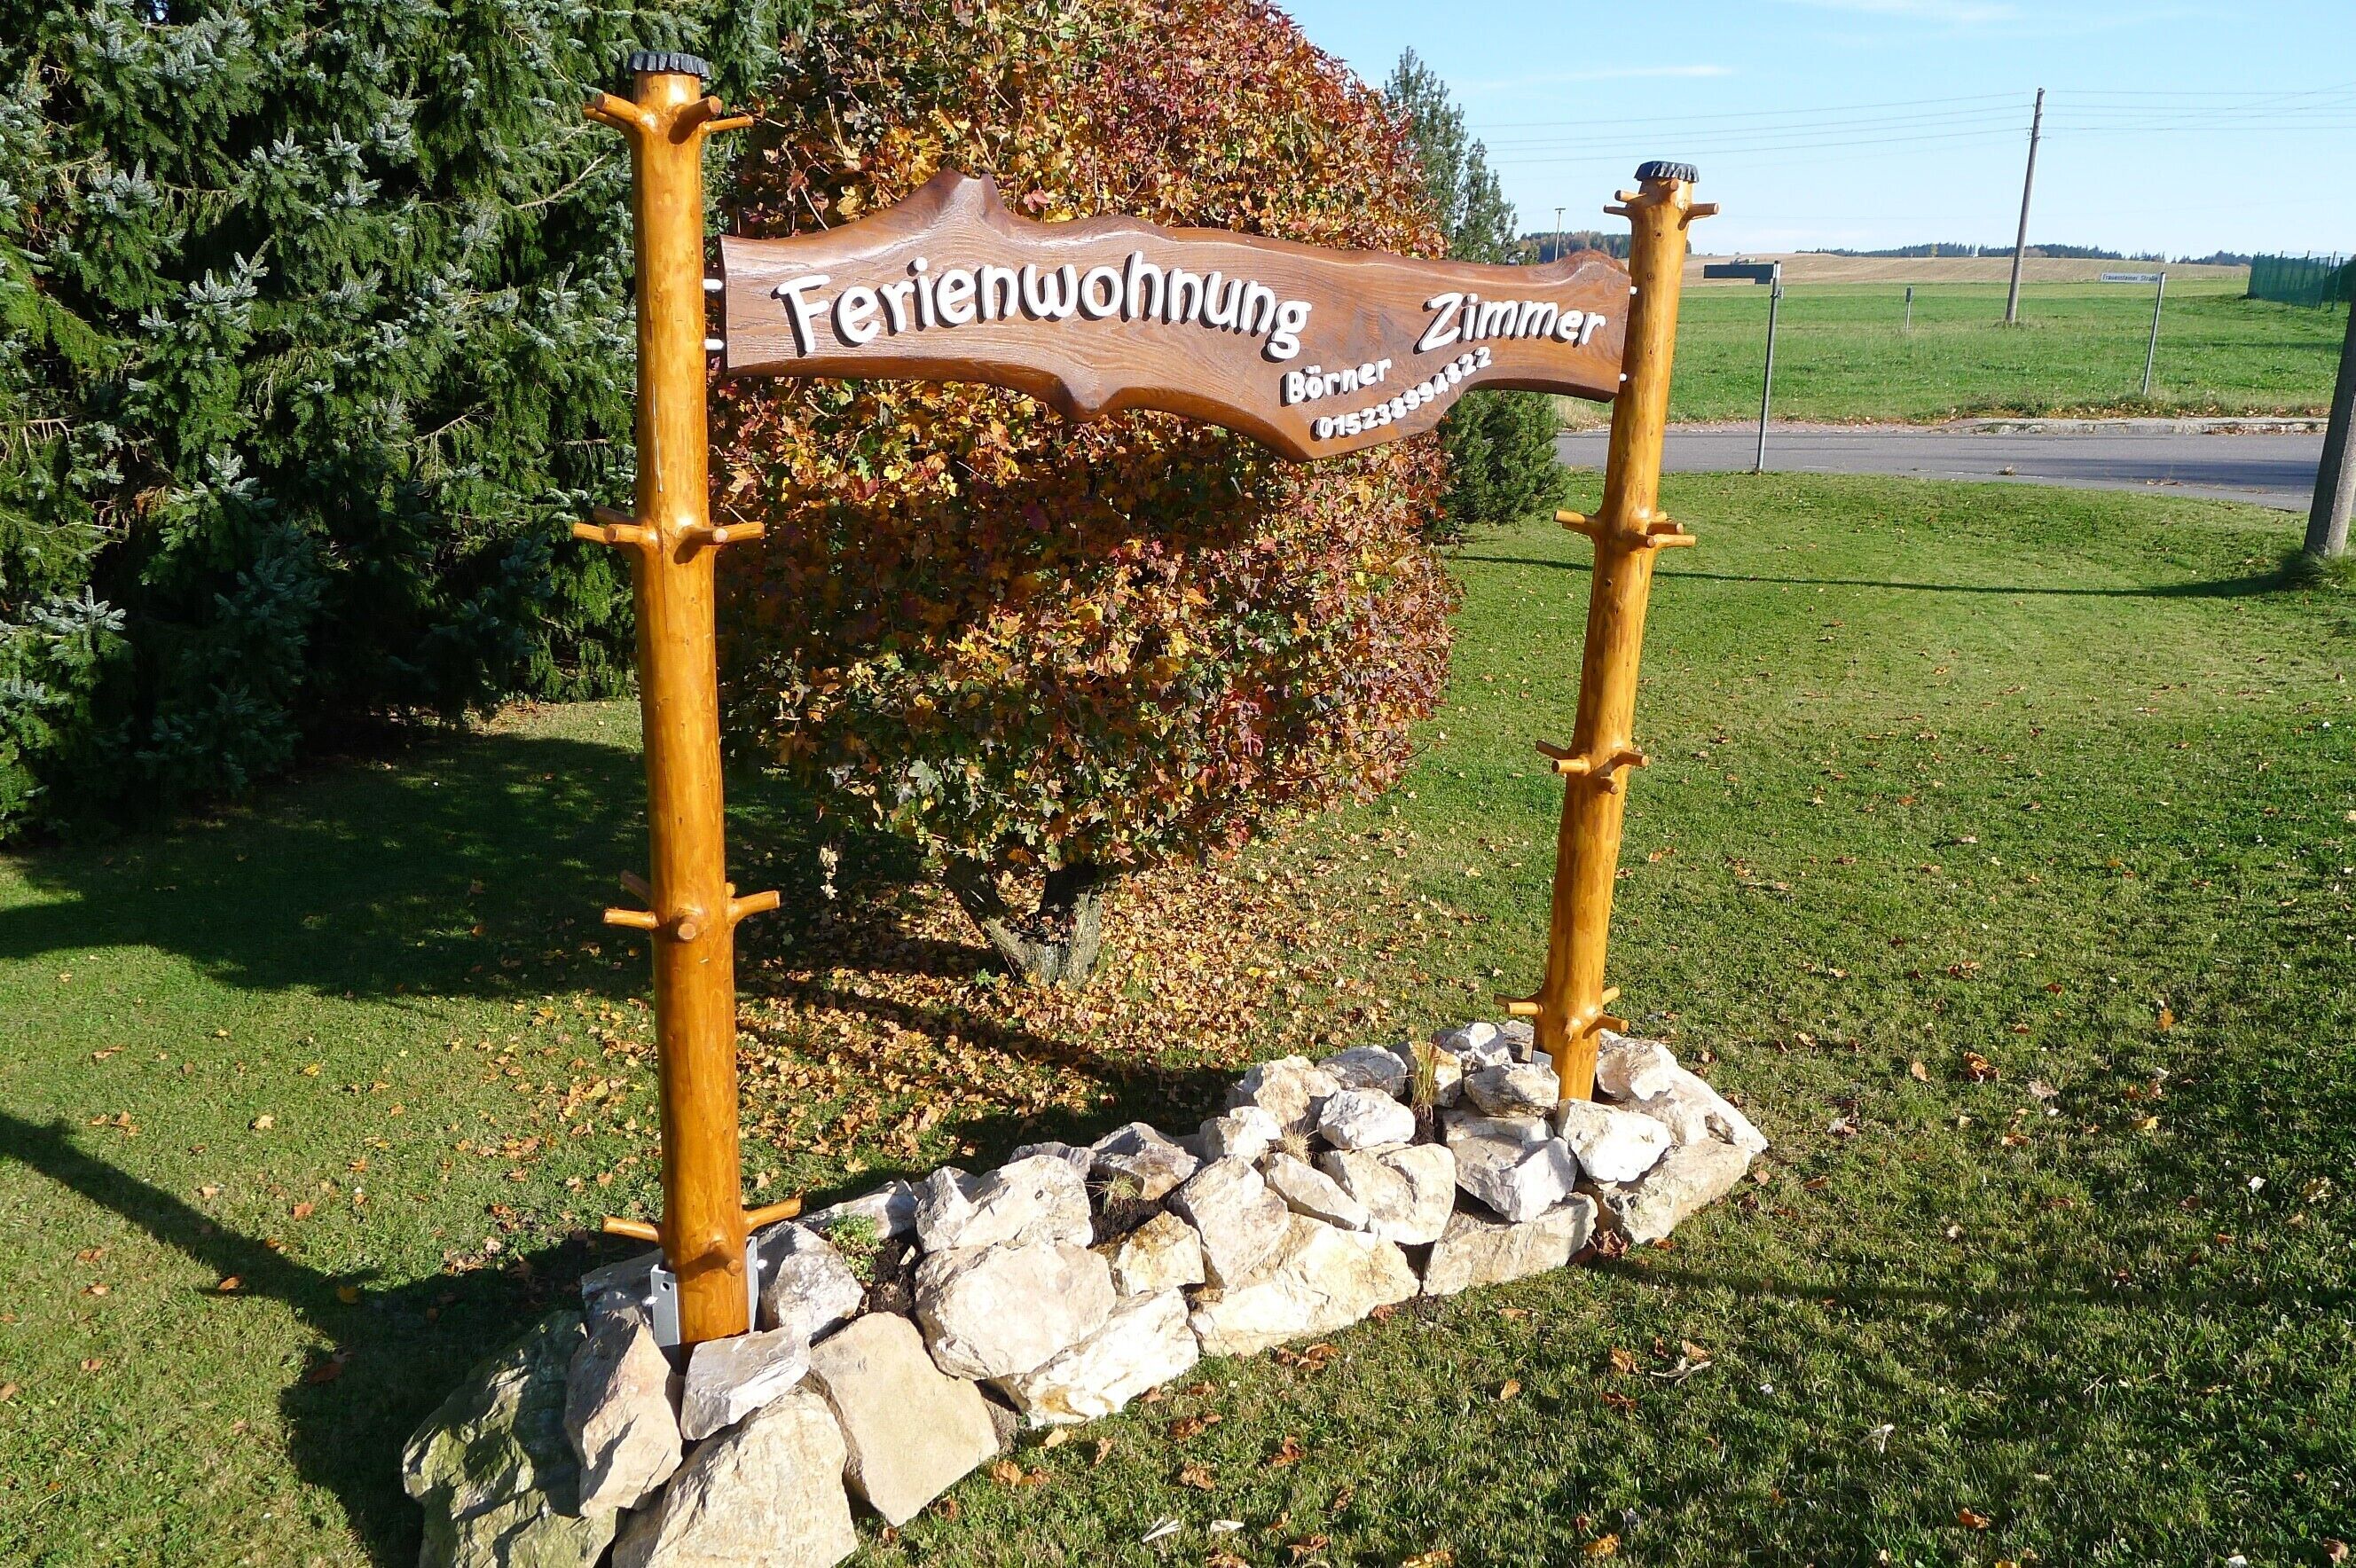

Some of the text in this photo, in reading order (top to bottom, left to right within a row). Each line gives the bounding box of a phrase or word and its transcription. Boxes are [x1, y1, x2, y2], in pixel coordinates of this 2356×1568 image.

[778, 250, 1313, 360] Ferienwohnung
[1418, 293, 1607, 353] Zimmer
[1285, 357, 1393, 404] Börner
[1316, 346, 1493, 439] 015238994822
